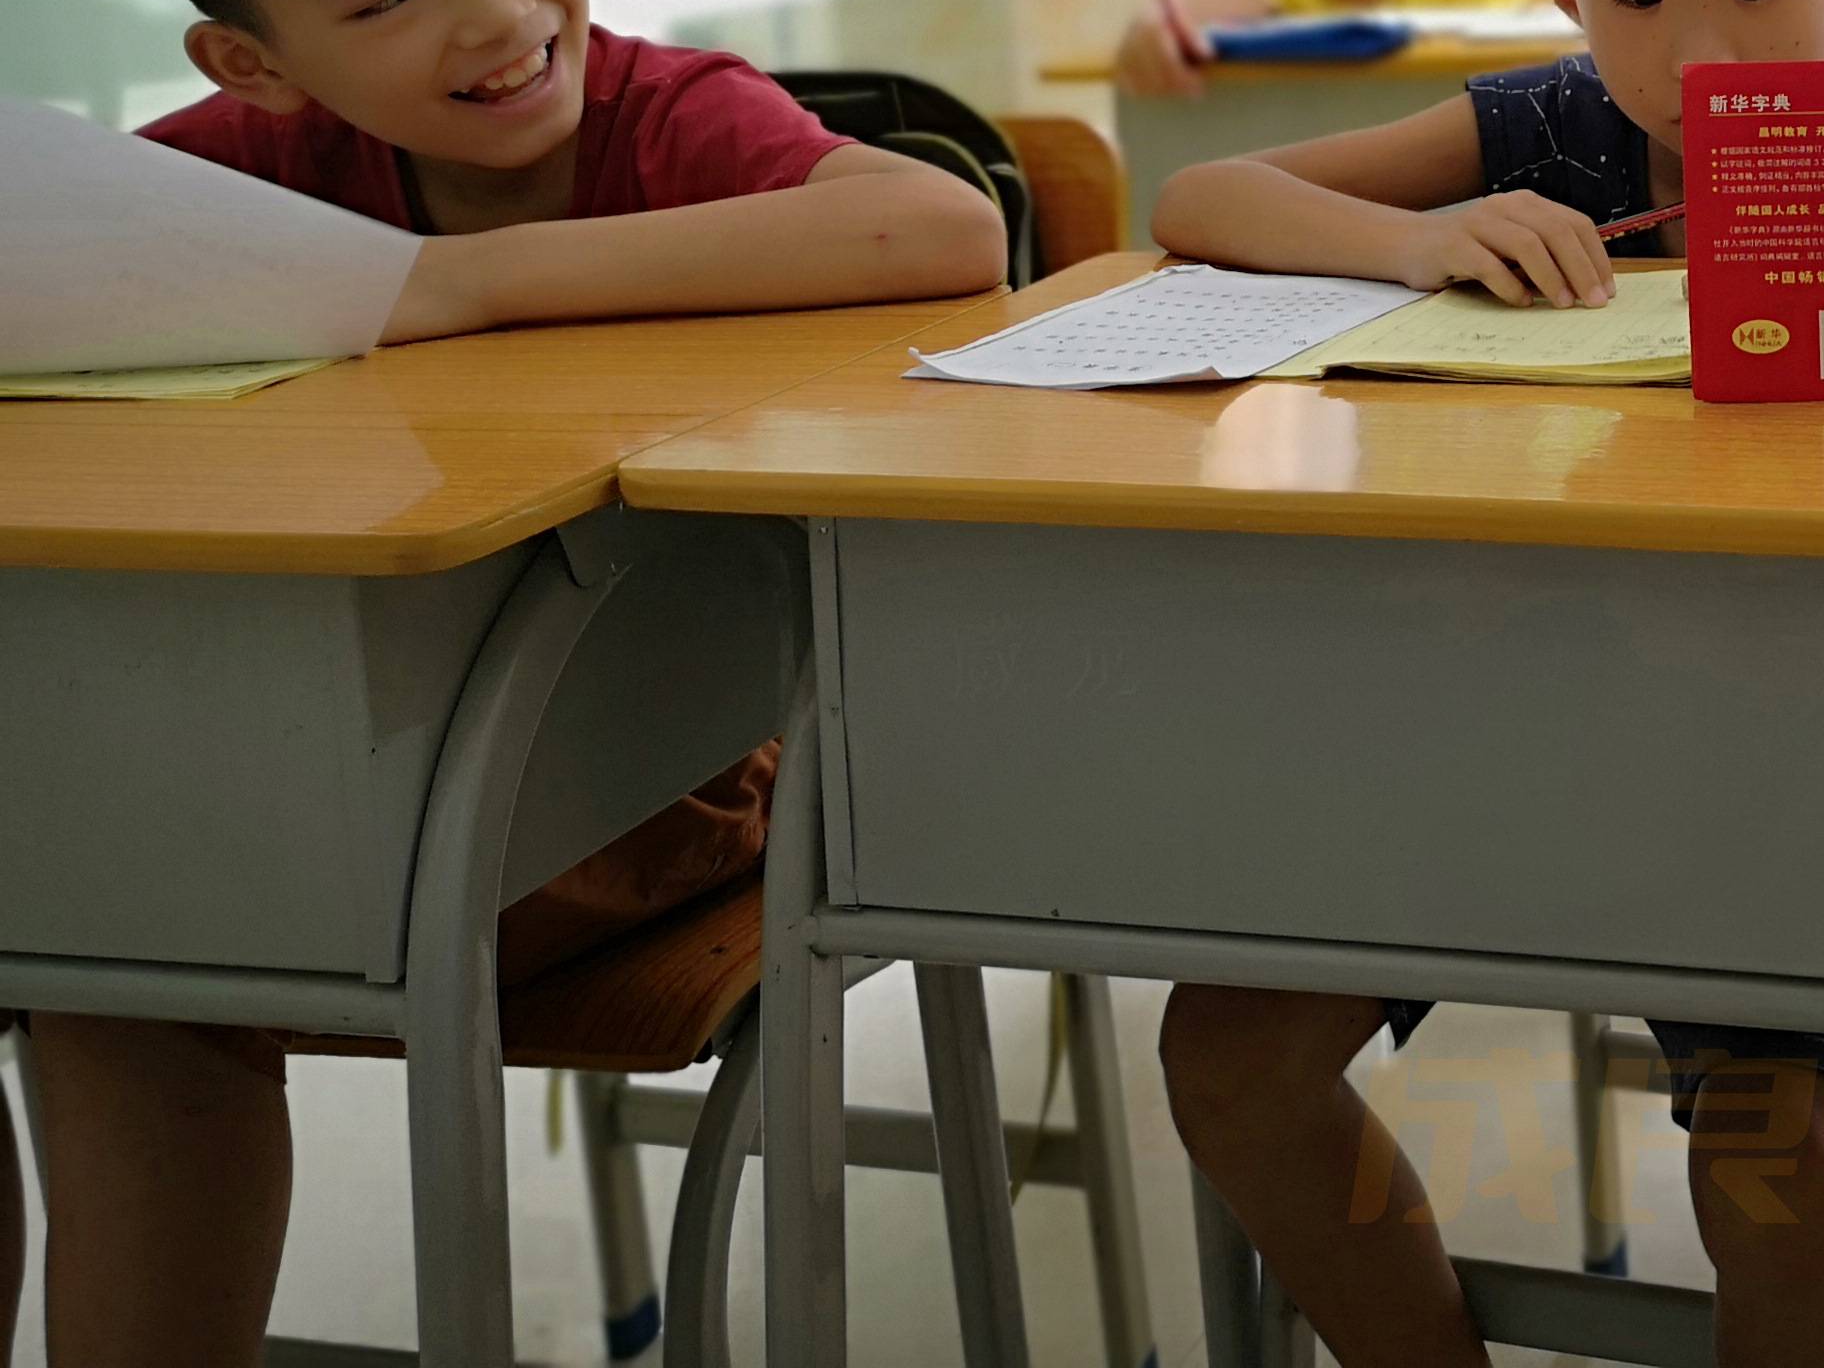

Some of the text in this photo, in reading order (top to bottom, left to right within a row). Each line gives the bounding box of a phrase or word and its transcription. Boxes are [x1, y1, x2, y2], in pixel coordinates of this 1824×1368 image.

[1709, 93, 1791, 113] 新华字典
[1735, 204, 1810, 216] 伴随国人成长
